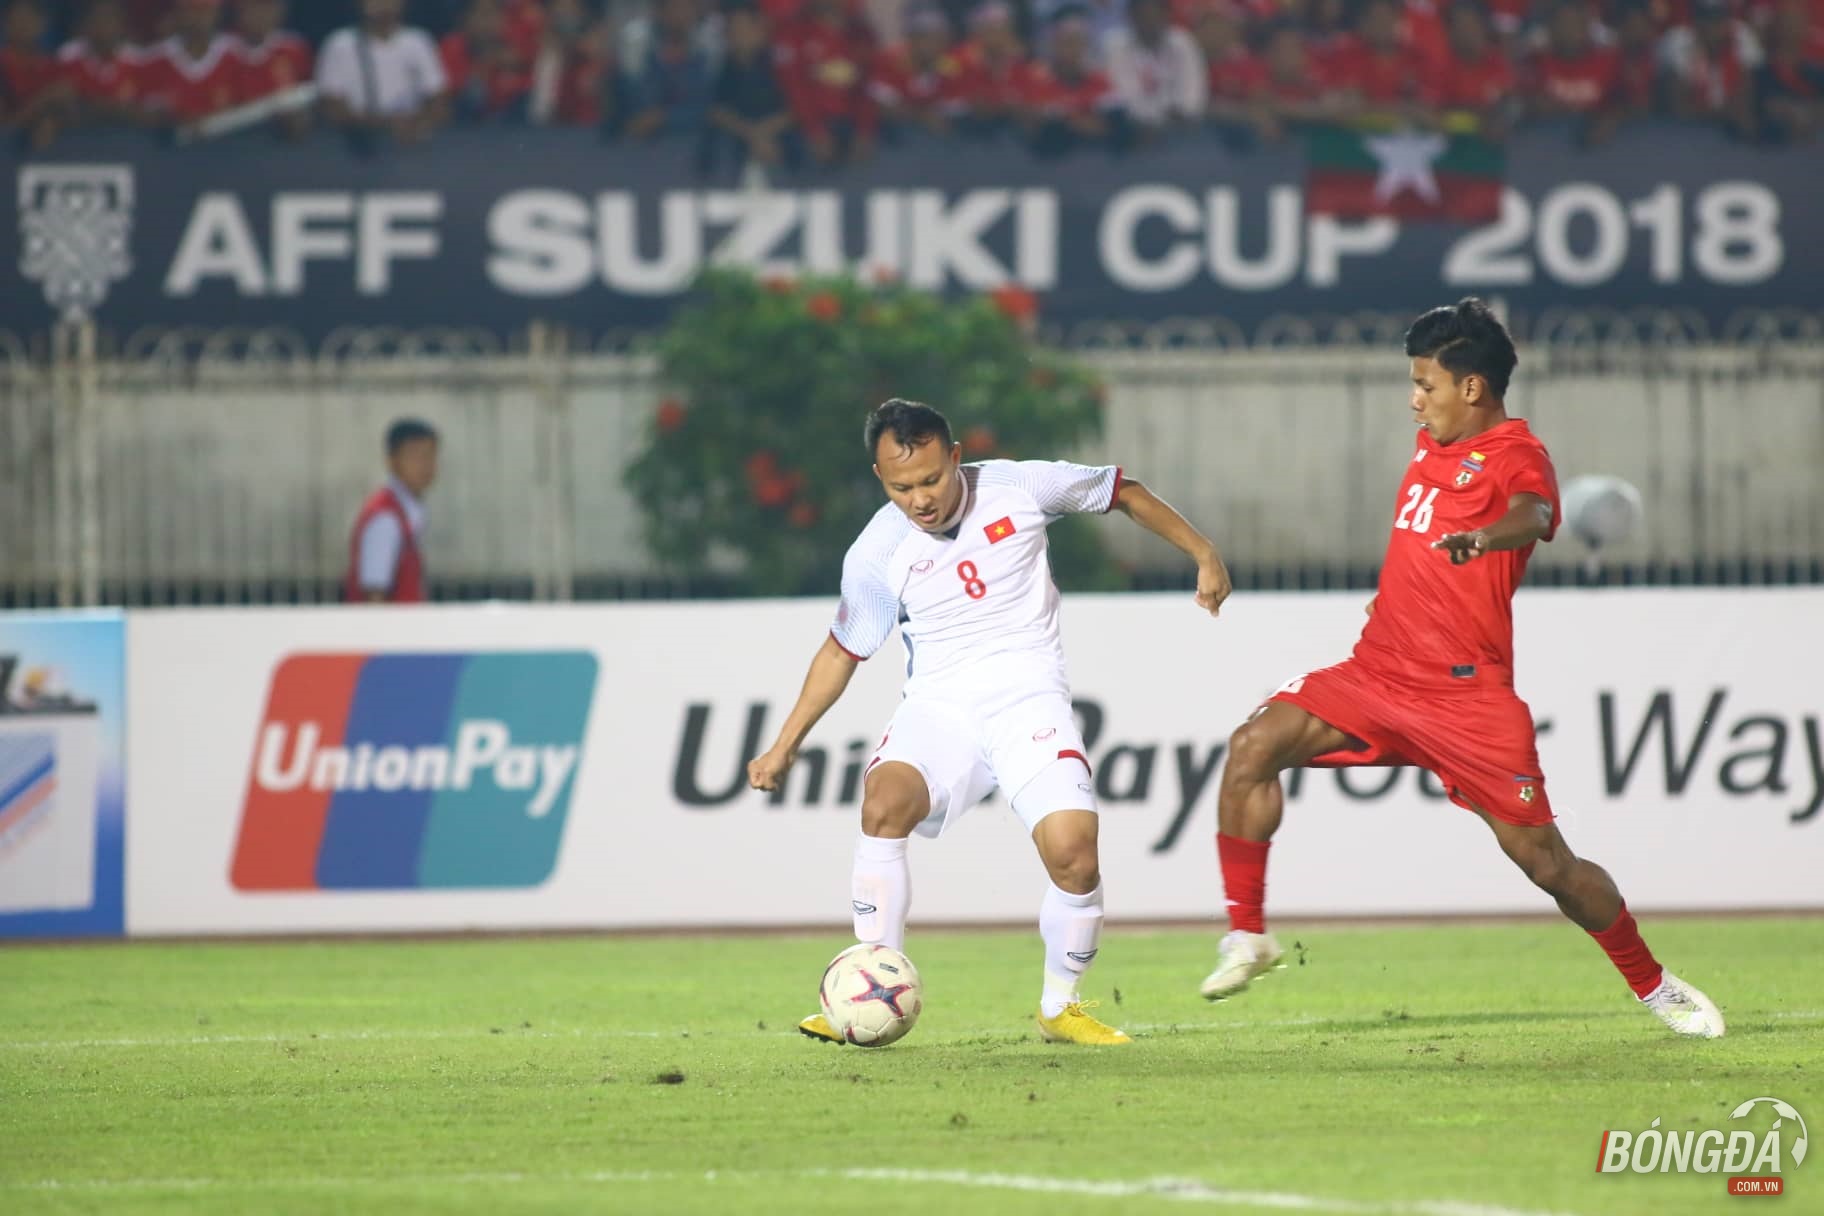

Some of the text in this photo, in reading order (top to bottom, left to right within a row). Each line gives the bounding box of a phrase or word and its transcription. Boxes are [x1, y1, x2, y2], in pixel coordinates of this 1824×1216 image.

[165, 181, 1785, 295] AFF SUZUKI CUP 2018
[1394, 483, 1440, 533] 26
[956, 560, 986, 599] 8
[256, 720, 578, 818] UnionPay
